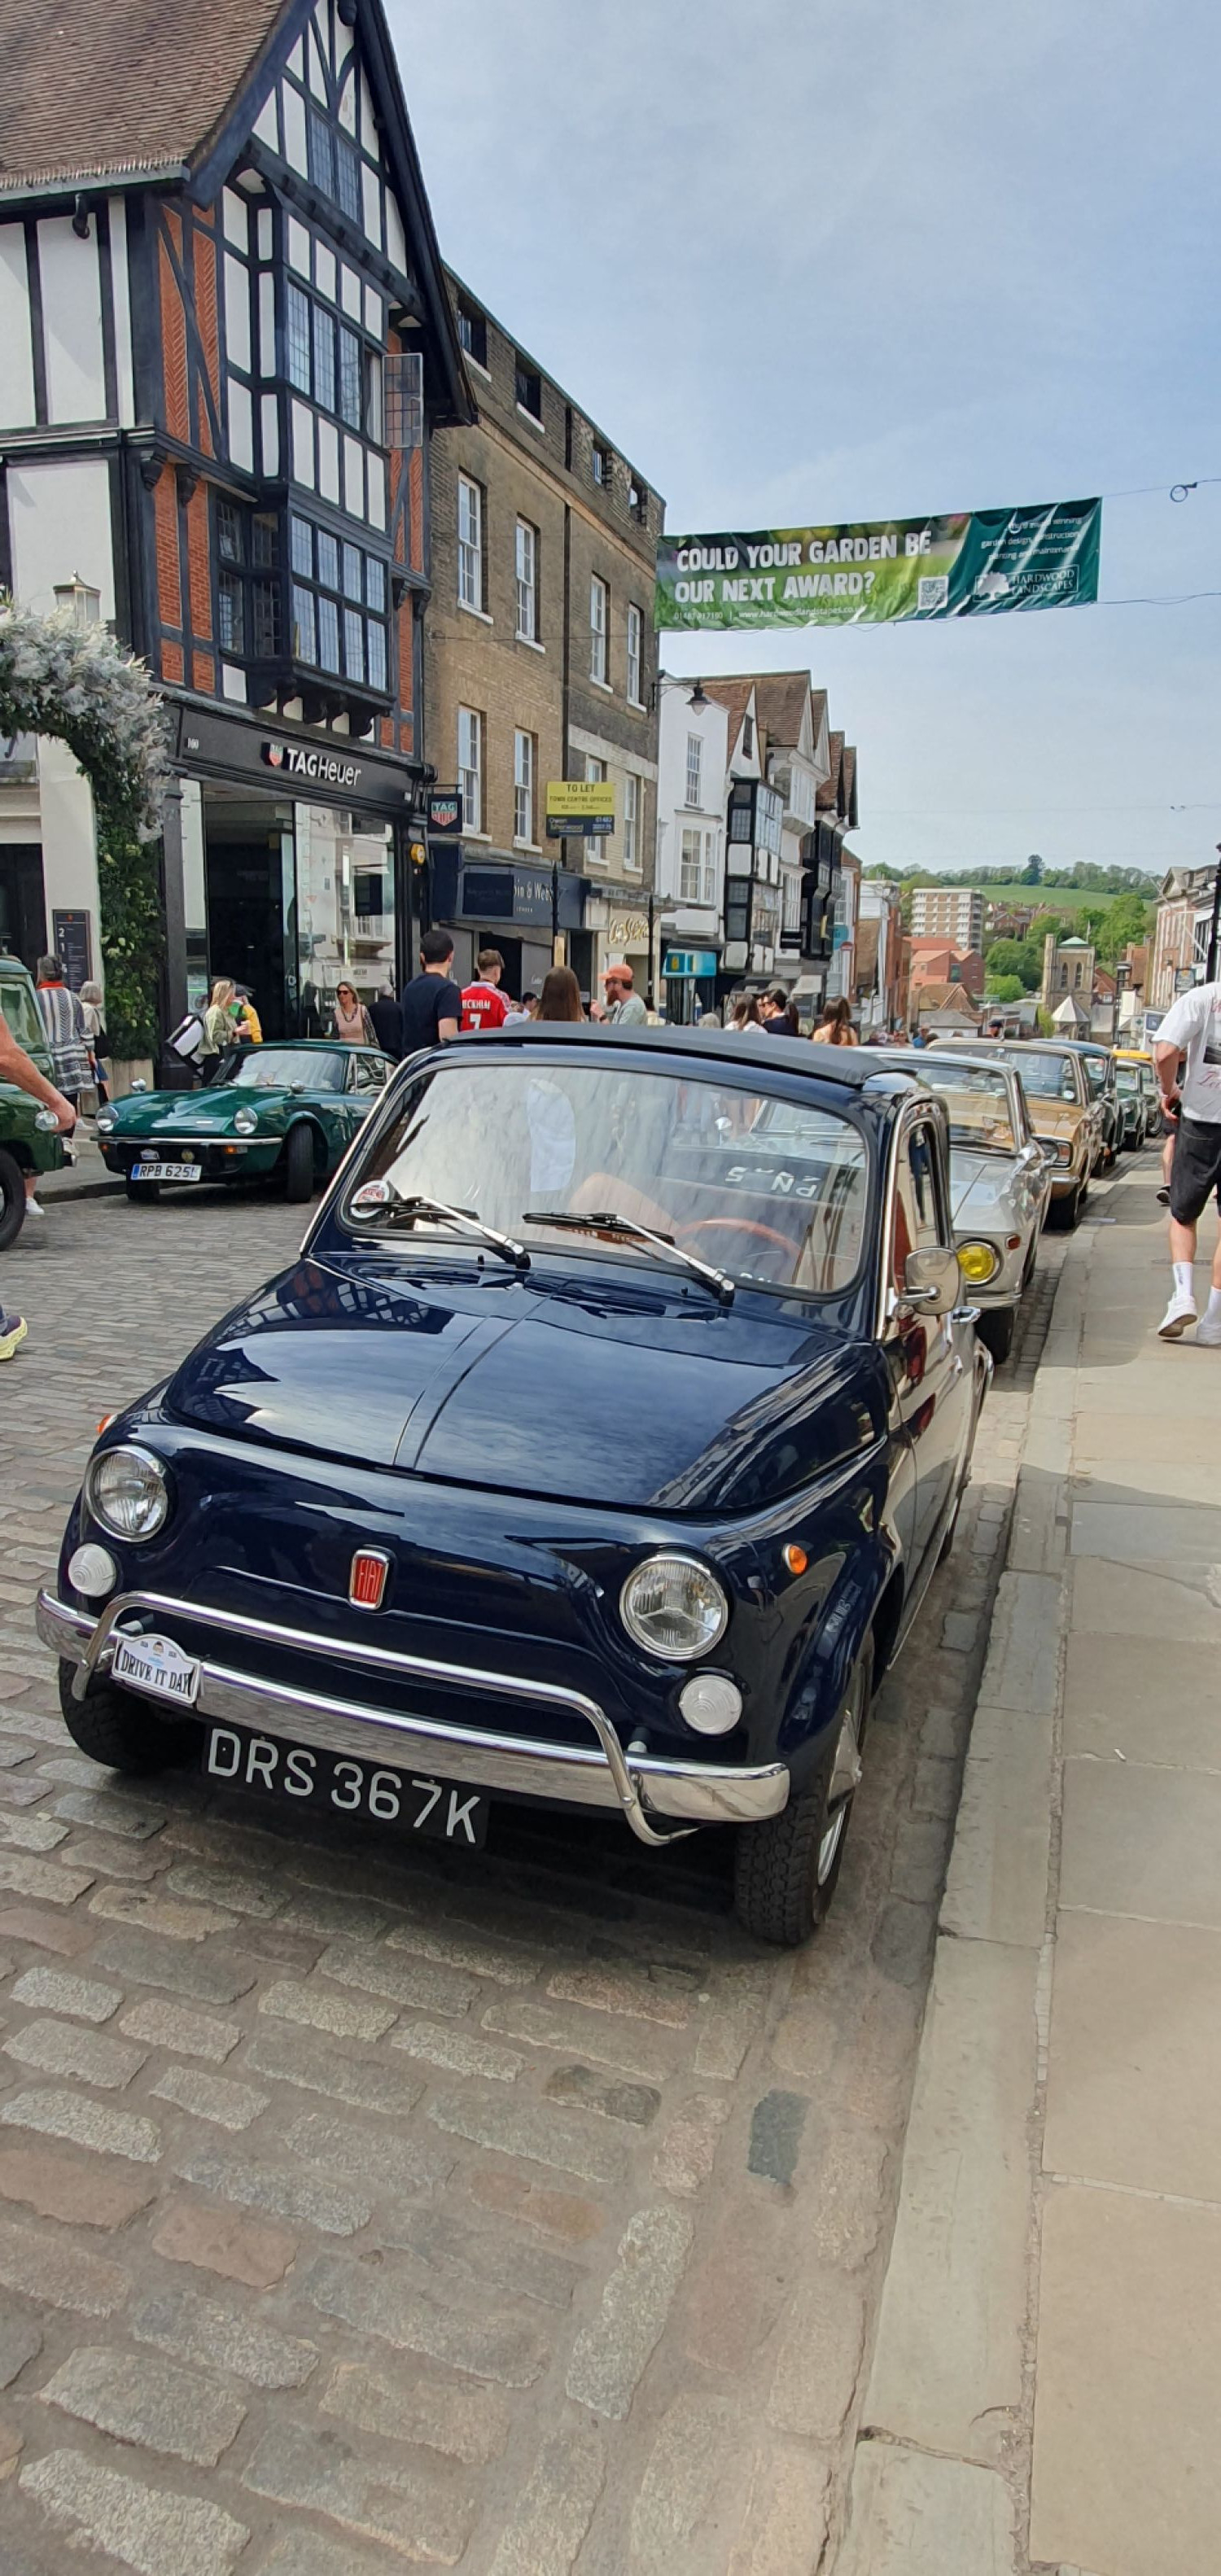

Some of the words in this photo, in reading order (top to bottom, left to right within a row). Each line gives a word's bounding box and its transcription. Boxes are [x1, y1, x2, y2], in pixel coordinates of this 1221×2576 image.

[676, 545, 739, 571] COULD
[746, 542, 802, 568] YOUR
[809, 534, 897, 563] GARDEN
[904, 530, 932, 557] BE
[674, 579, 715, 603] OUR
[722, 576, 776, 602] NEXT
[782, 571, 876, 600] AWARD?
[567, 784, 578, 793] TO
[580, 784, 596, 793] LET
[432, 802, 456, 811] TAG
[59, 927, 65, 938] 2
[470, 1013, 482, 1029] 7
[140, 1165, 163, 1177] RPB
[356, 1559, 383, 1603] FIAT
[120, 1649, 152, 1682] DRIVE
[155, 1668, 168, 1686] IT
[208, 1727, 317, 1796] DRS
[330, 1761, 481, 1844] 367K
